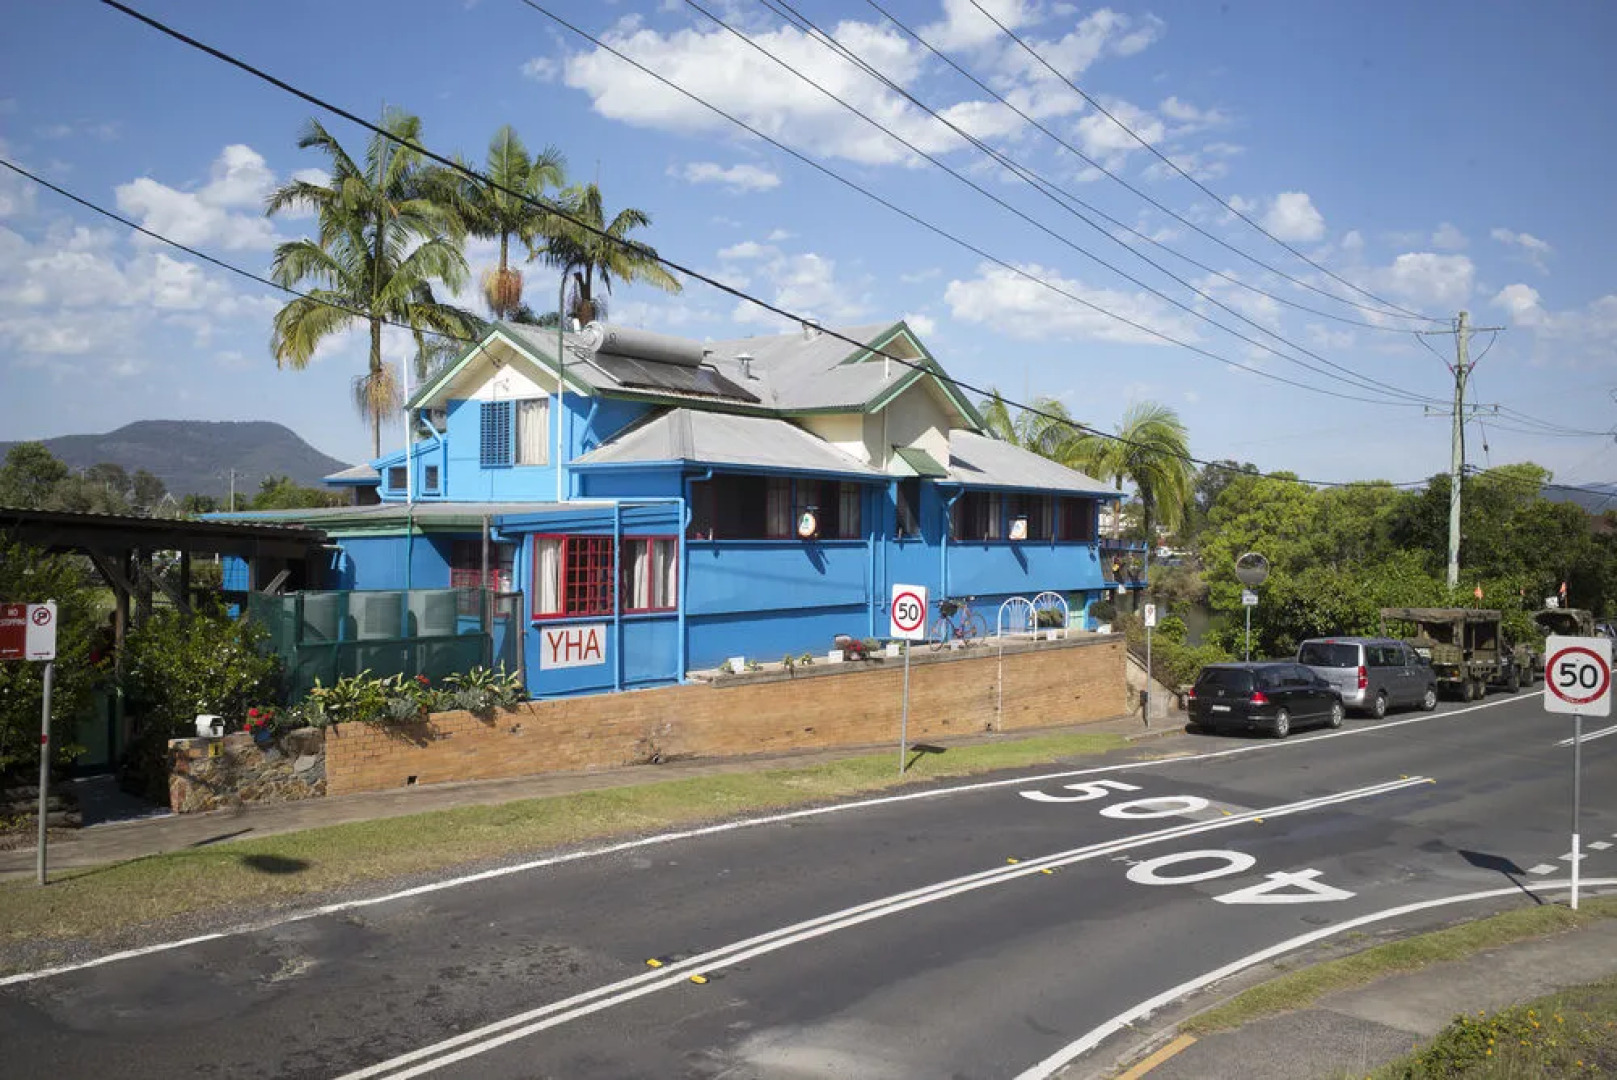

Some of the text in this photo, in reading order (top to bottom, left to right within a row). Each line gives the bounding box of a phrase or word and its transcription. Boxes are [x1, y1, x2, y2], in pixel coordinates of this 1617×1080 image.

[898, 602, 919, 621] 50
[547, 629, 600, 663] YHA
[1560, 663, 1598, 689] 50
[1019, 780, 1208, 819] 50
[1126, 849, 1357, 904] 40
